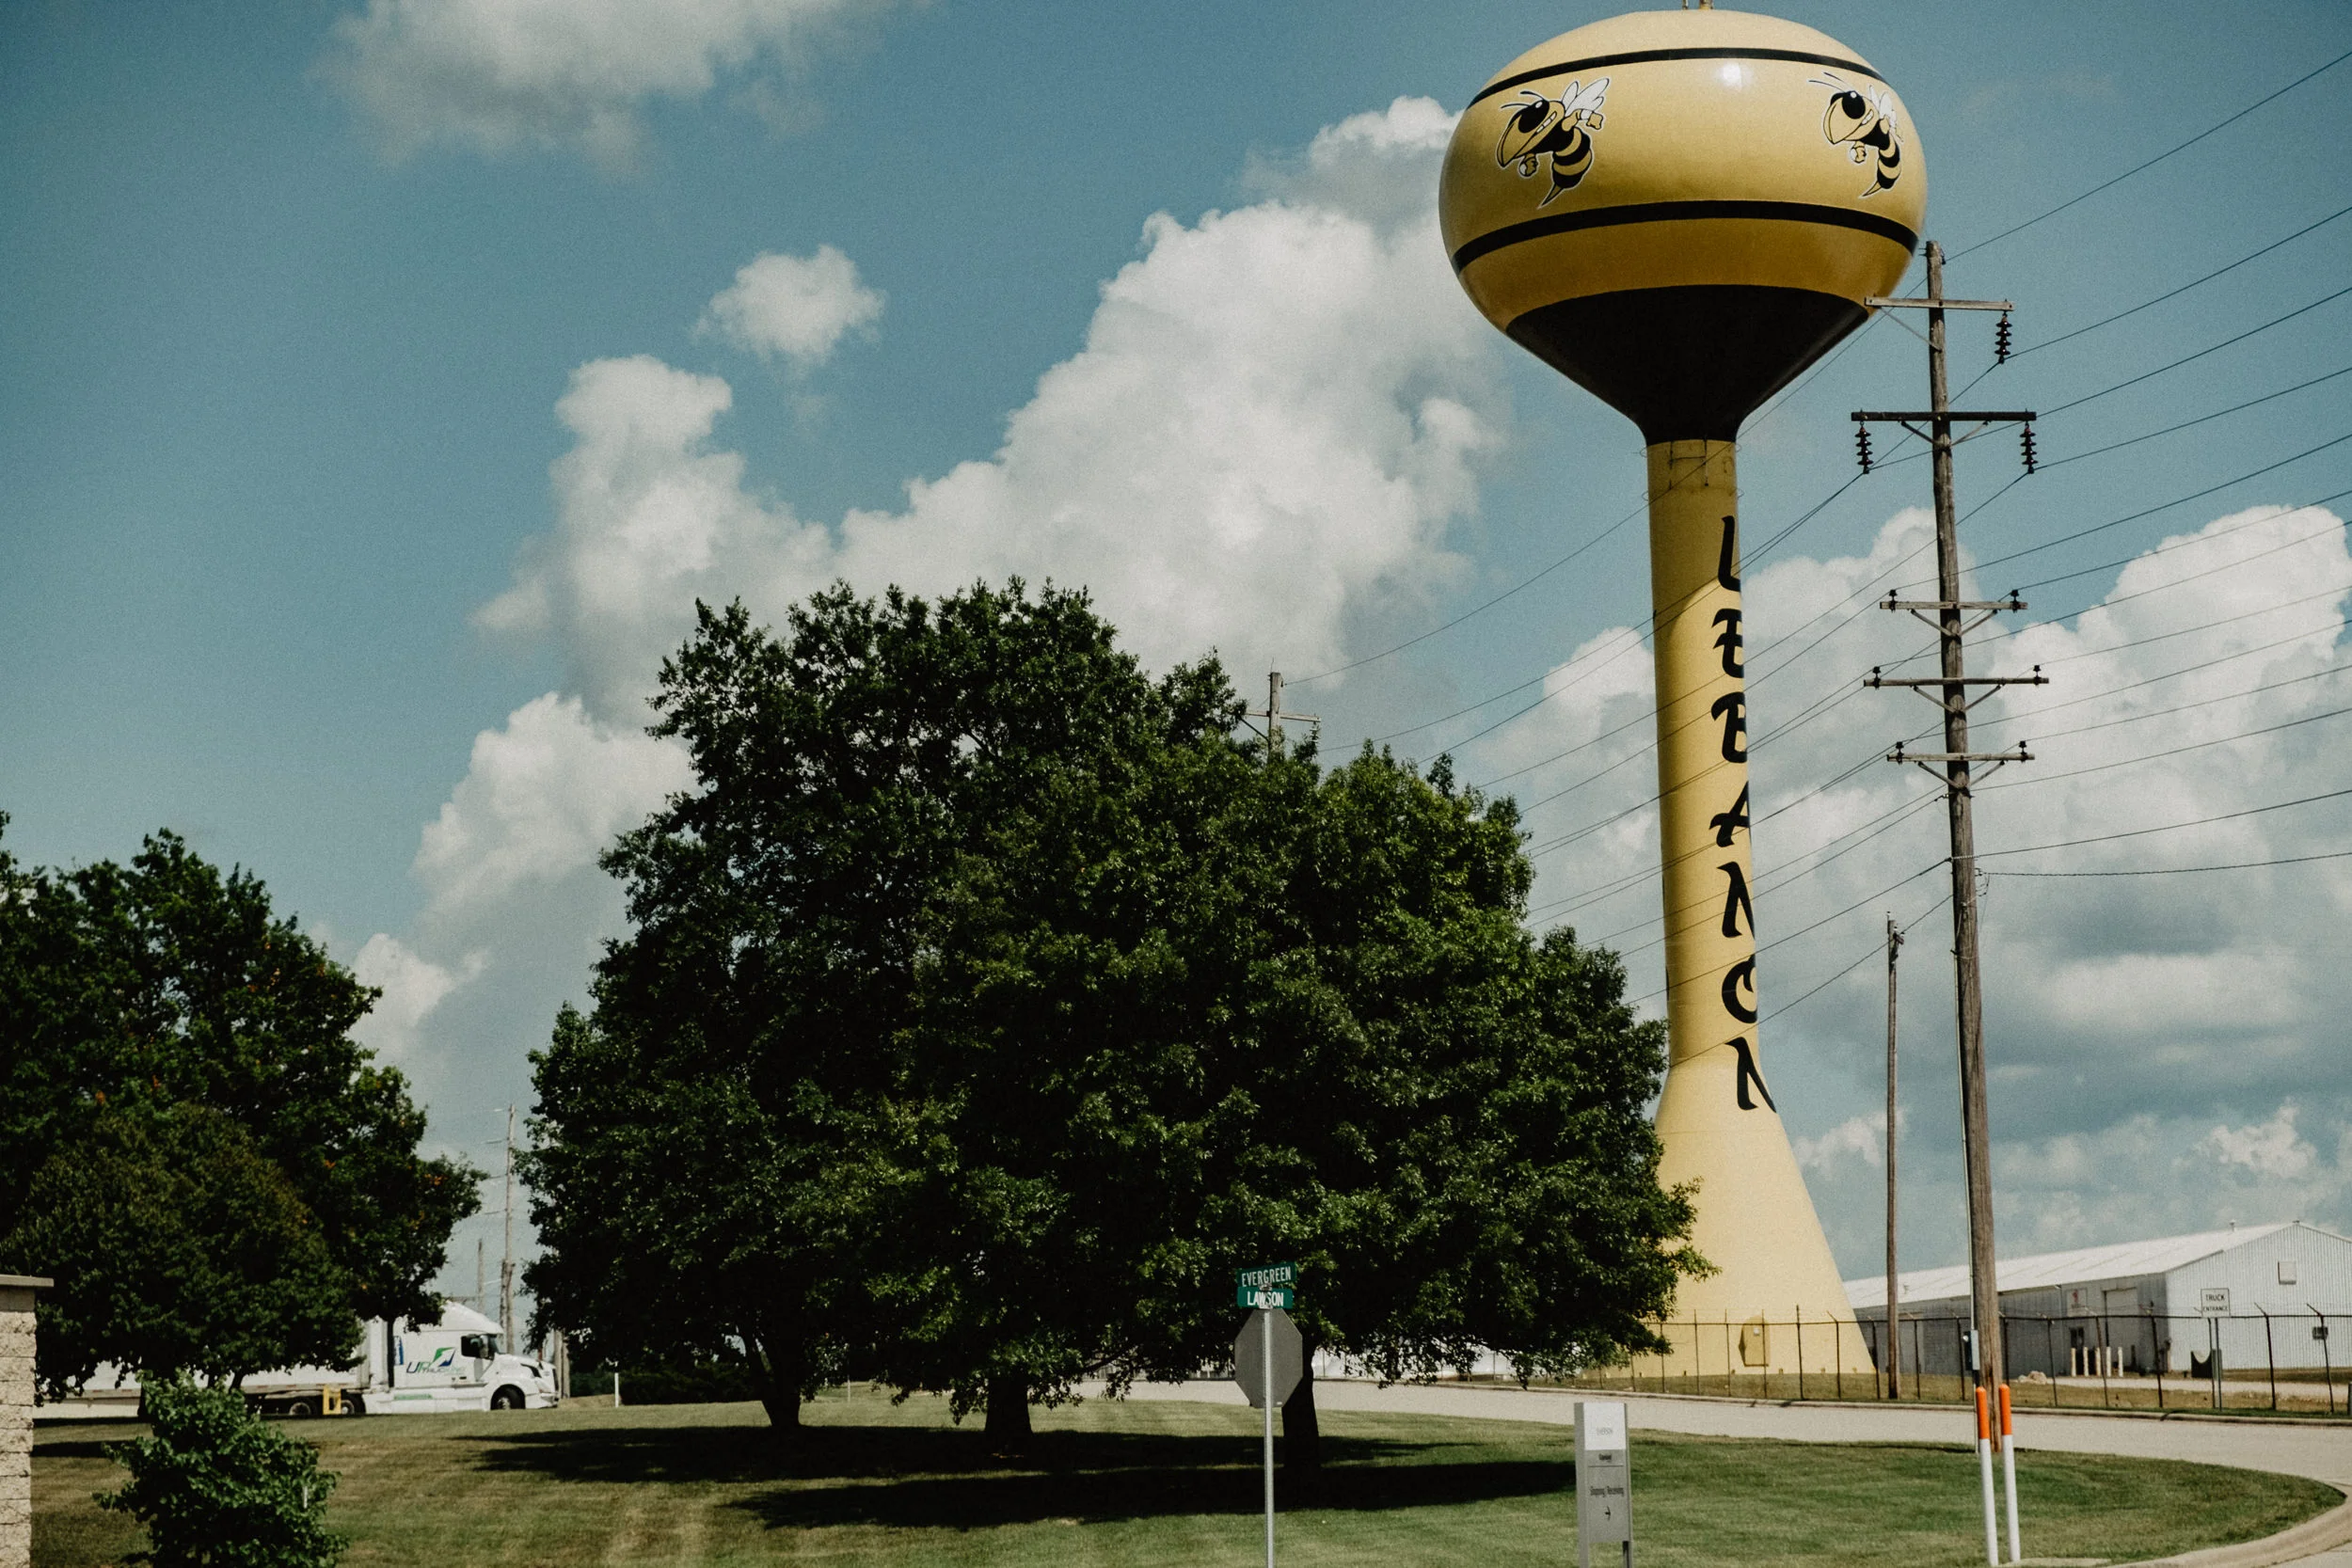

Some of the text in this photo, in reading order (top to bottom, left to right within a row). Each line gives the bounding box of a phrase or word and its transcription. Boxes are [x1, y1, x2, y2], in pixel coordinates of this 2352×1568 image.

[1242, 1266, 1291, 1288] EVERGREEN
[1247, 1291, 1284, 1307] LAWSON
[2205, 1293, 2225, 1302] TRUCK
